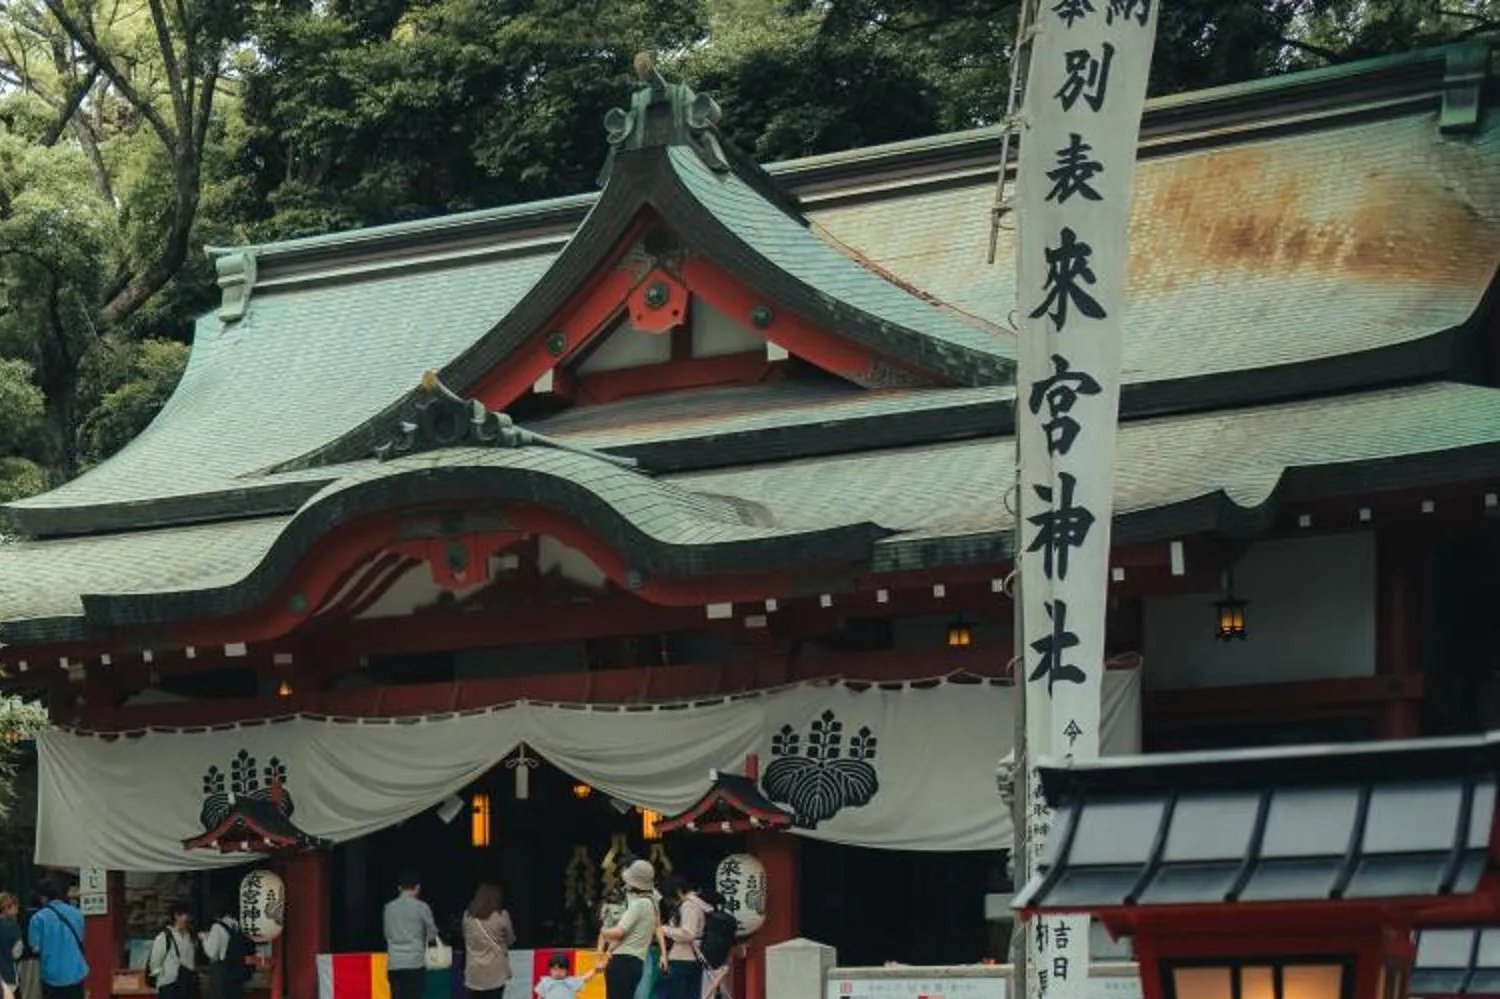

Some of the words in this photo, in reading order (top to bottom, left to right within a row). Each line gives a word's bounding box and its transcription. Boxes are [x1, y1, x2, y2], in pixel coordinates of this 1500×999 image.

[1026, 42, 1114, 696] 別表來宮神社
